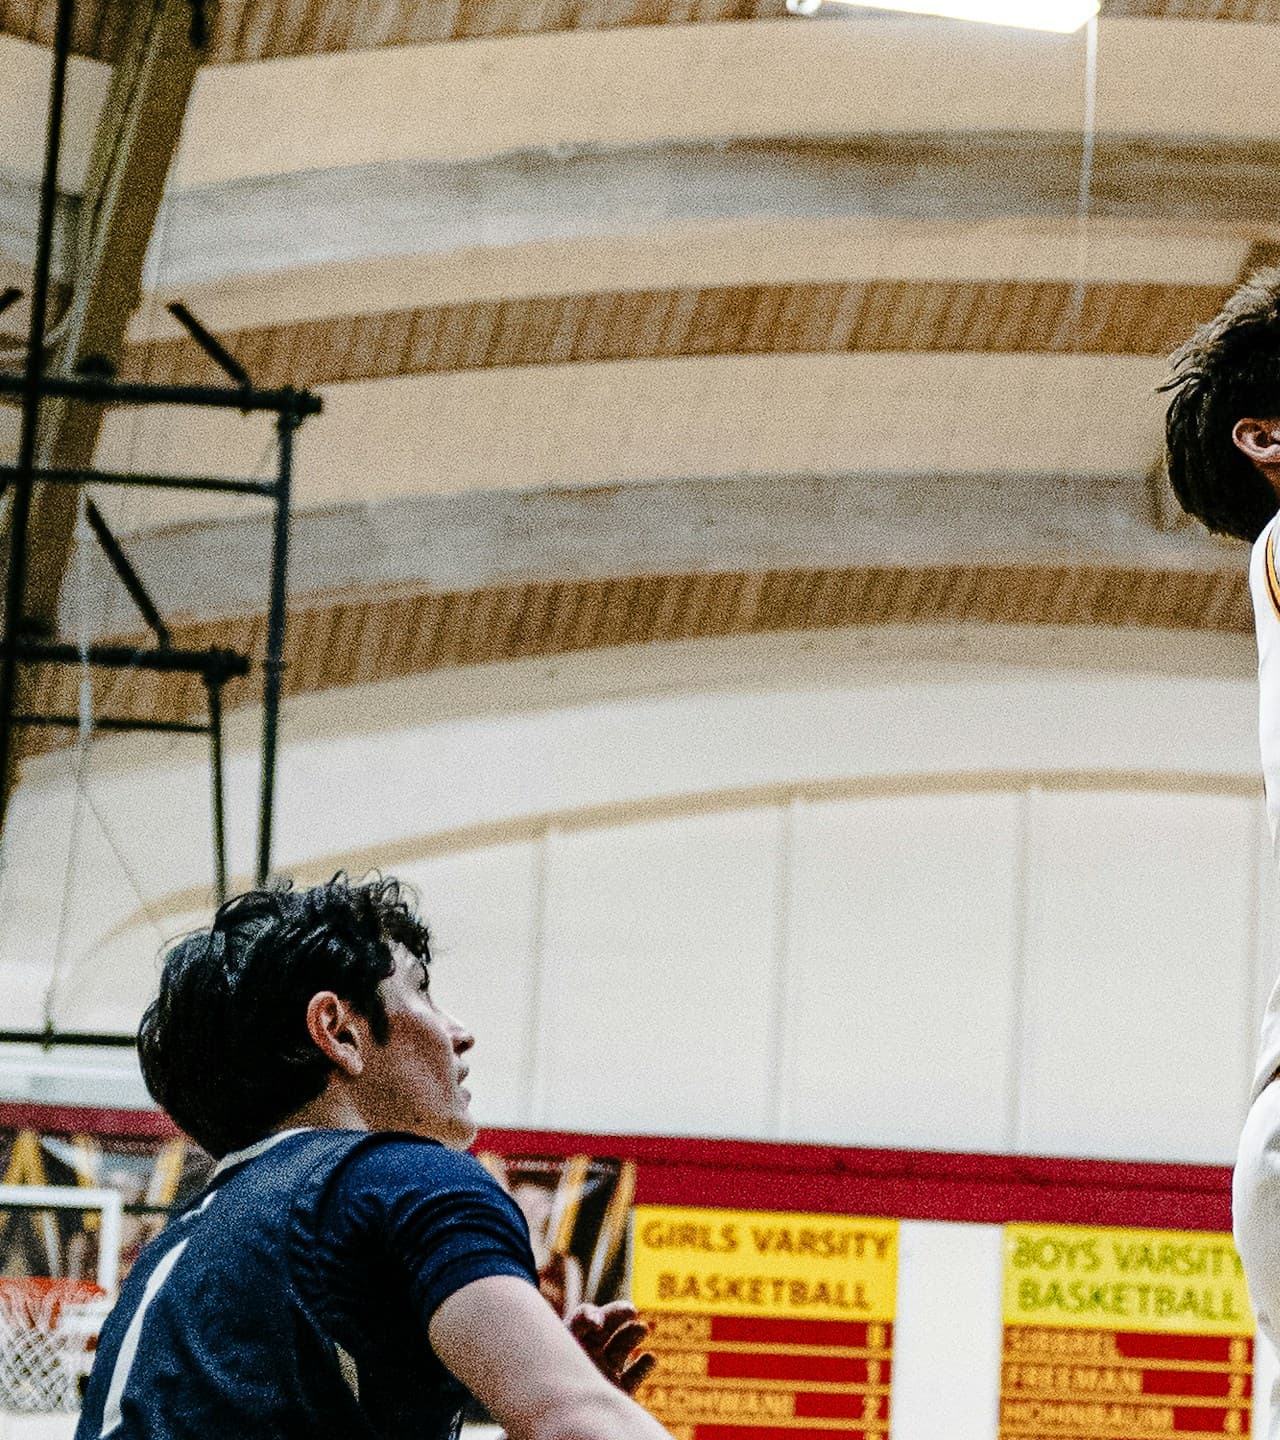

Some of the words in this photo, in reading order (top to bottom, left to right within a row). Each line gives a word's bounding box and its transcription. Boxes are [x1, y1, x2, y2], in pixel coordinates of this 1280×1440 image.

[642, 1221, 738, 1253] GIRLS
[753, 1226, 891, 1260] VARSITY
[1012, 1236, 1100, 1270] BOYS
[1111, 1244, 1241, 1277] VARSITY
[657, 1272, 871, 1311] BASKETBALL
[1018, 1278, 1241, 1320] BASKETBALL
[98, 1237, 191, 1440] 1
